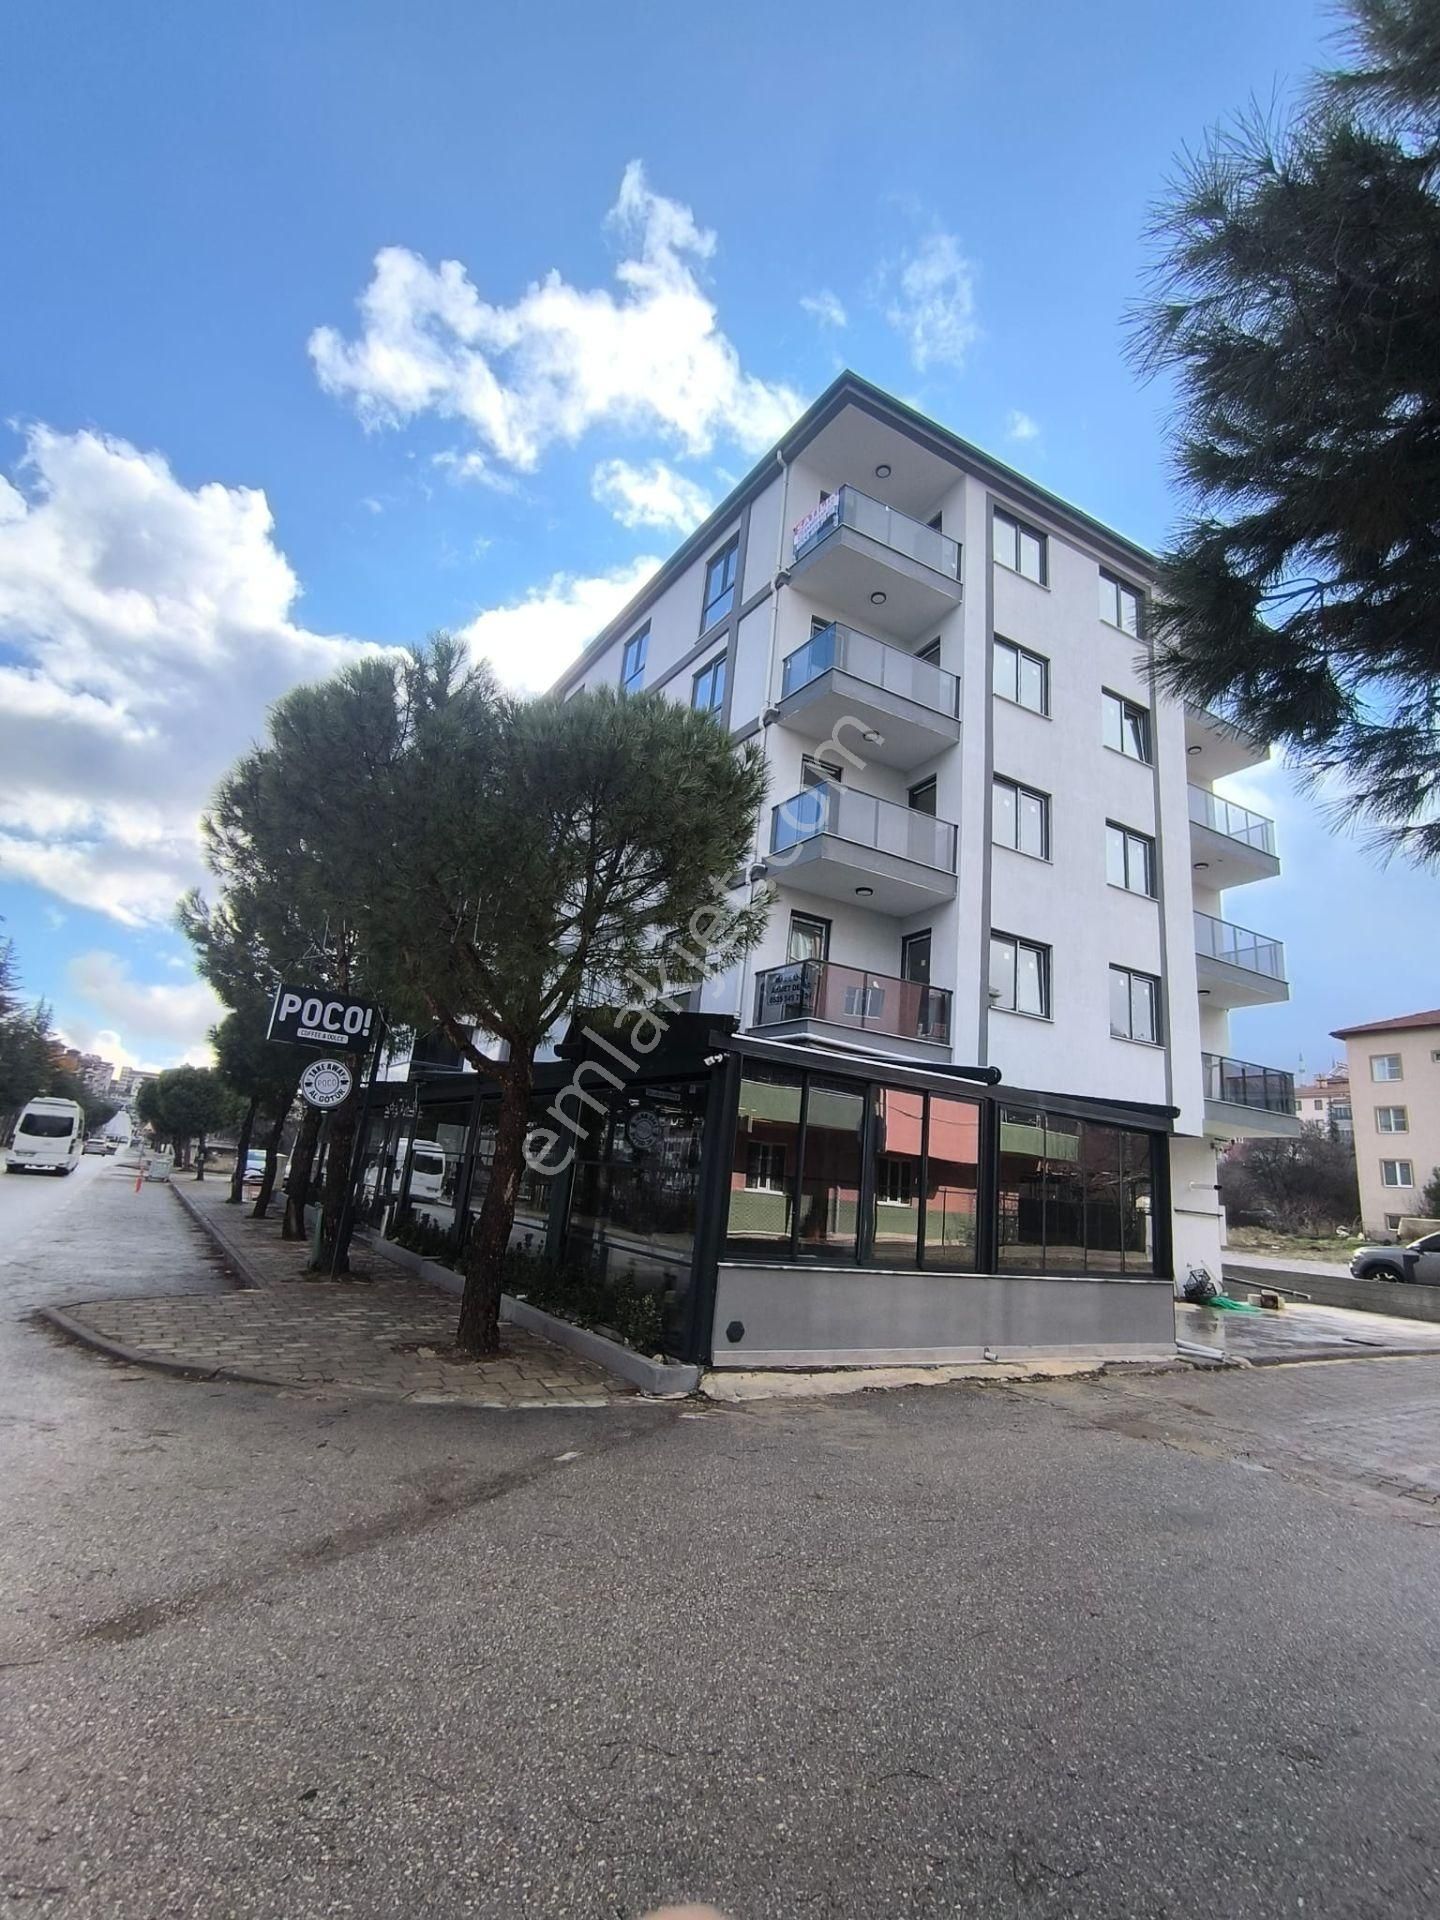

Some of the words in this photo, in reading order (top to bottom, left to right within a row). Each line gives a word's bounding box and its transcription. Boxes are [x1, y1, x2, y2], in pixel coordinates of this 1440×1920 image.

[278, 993, 373, 1037] POCO!
[300, 1029, 322, 1039] COFFEE
[308, 1063, 326, 1078] TAKE
[326, 1063, 346, 1078] AWAY
[317, 1078, 337, 1088] POCO
[308, 1090, 318, 1099] AL
